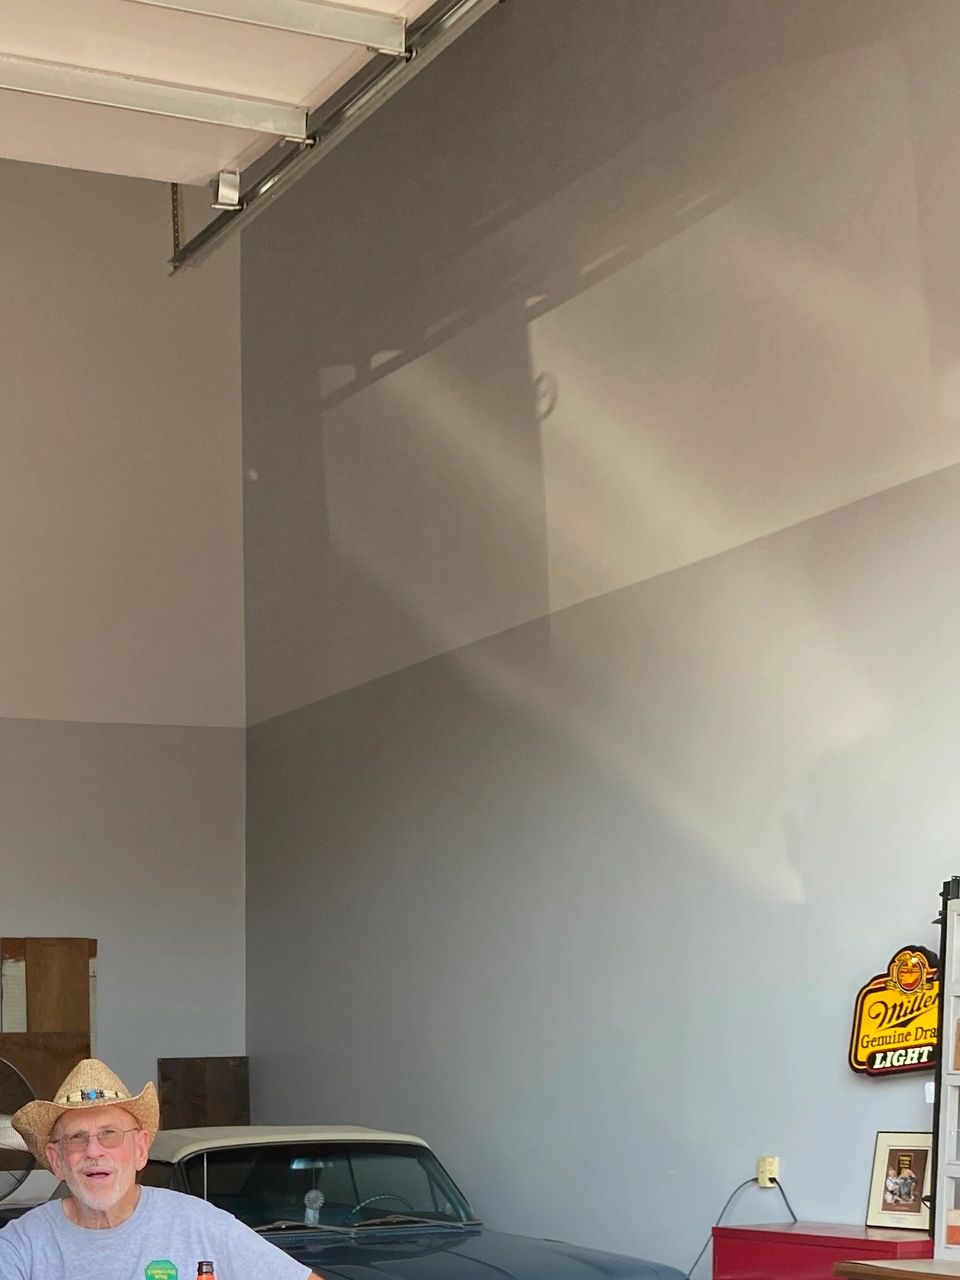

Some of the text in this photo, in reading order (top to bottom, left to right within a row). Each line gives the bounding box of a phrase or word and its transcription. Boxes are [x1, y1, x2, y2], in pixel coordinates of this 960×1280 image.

[868, 991, 938, 1029] Miller
[861, 1026, 937, 1049] Genuine Dra
[873, 1046, 932, 1069] LIGHT
